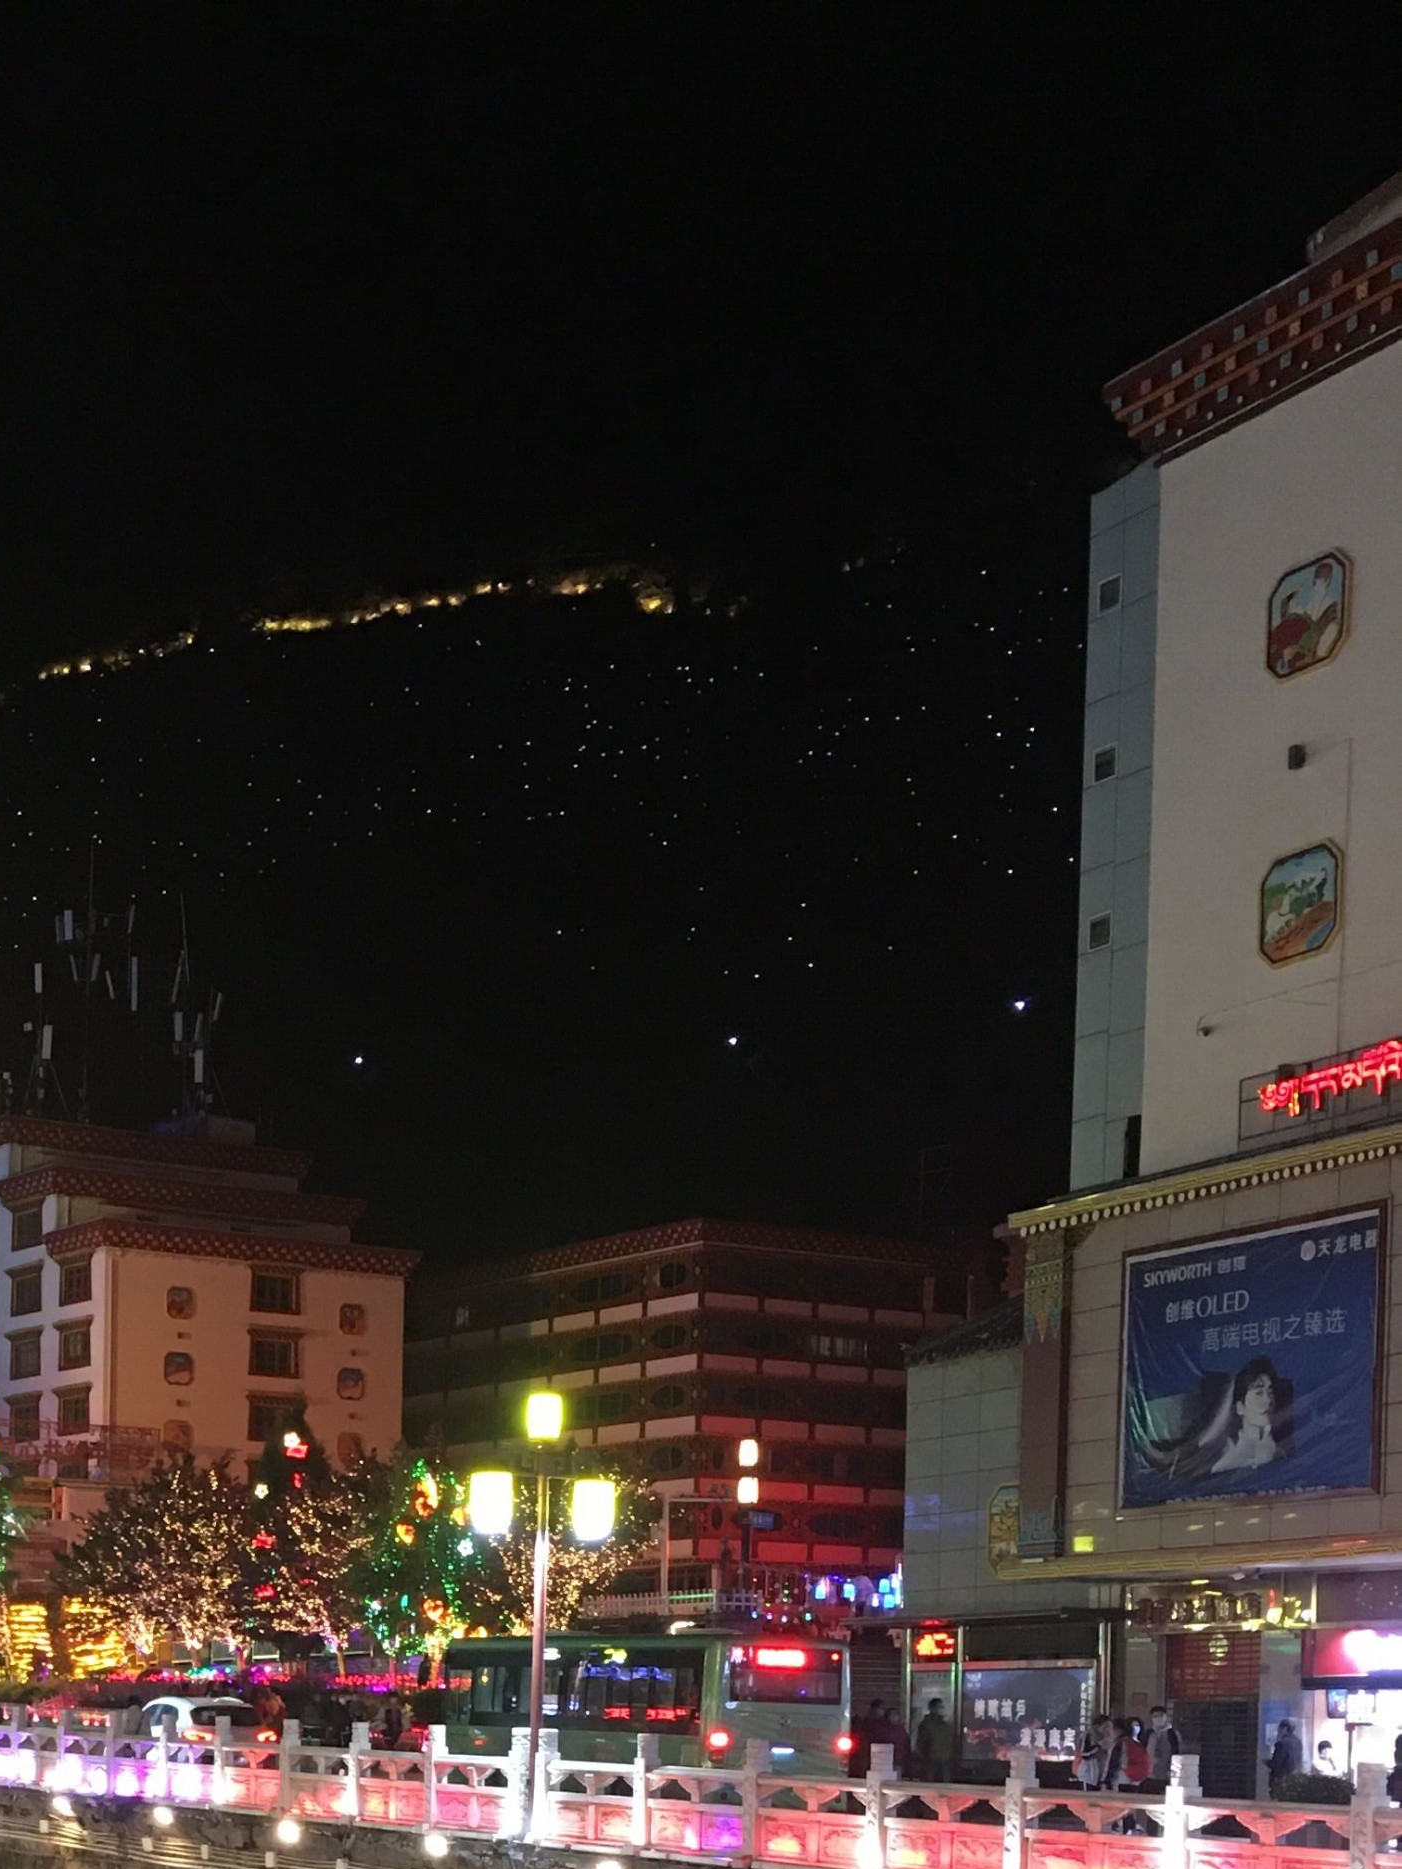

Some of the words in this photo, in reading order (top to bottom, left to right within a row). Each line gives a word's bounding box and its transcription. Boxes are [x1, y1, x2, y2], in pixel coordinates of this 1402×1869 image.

[1317, 1229, 1377, 1257] 天龙电器
[1143, 1260, 1212, 1288] SKYWORTH
[1165, 1290, 1249, 1323] 创维OLED
[1202, 1308, 1347, 1353] 高端电视之臻选
